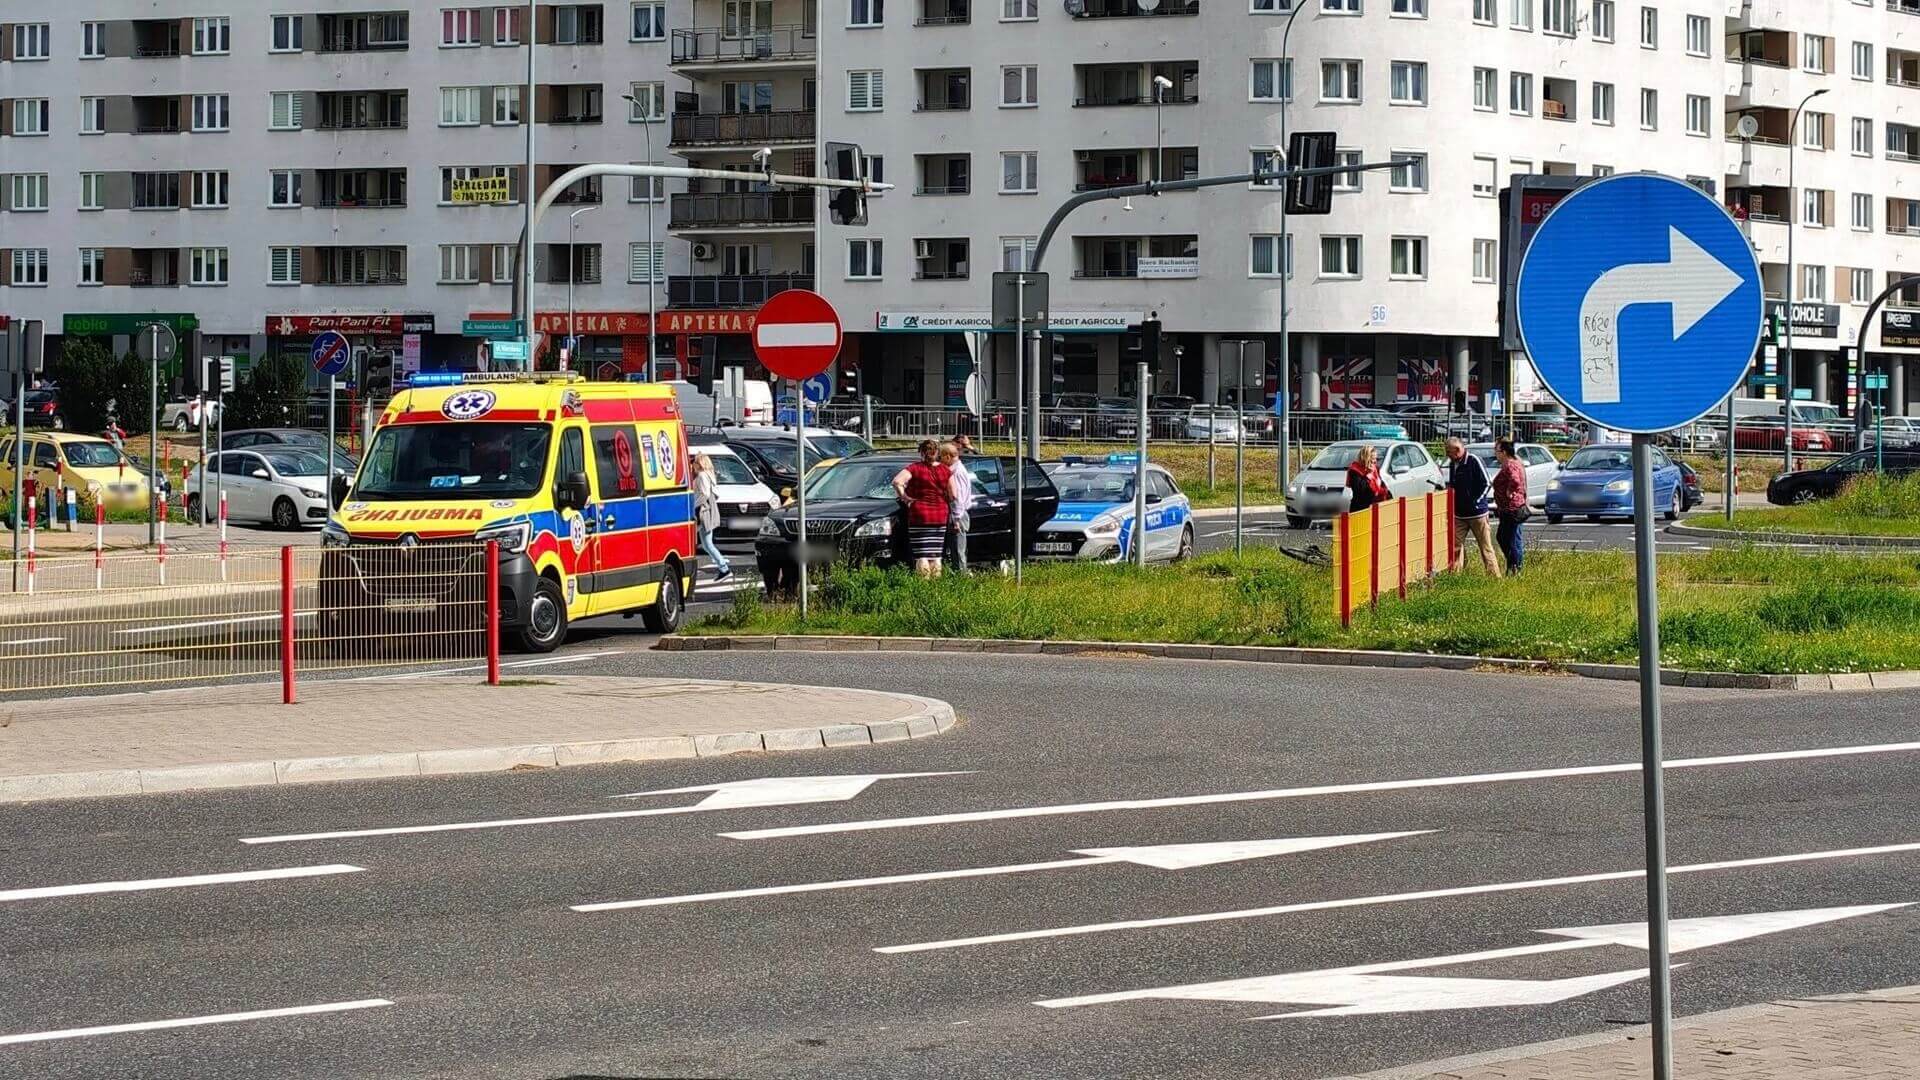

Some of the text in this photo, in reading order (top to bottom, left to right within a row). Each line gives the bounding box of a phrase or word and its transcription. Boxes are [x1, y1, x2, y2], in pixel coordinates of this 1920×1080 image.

[453, 180, 507, 190] SPRZEDAM
[1372, 306, 1386, 320] 56
[1775, 304, 1825, 322] ALOHOLE
[309, 317, 334, 327] Pan
[340, 316, 369, 327] Pani
[371, 316, 392, 326] Fit
[670, 315, 742, 330] APTEKA
[922, 316, 952, 326] CRÉDIT
[954, 317, 993, 326] AGRICOL
[1081, 317, 1126, 326] AGRICOLE
[464, 372, 516, 381] AMBULANS
